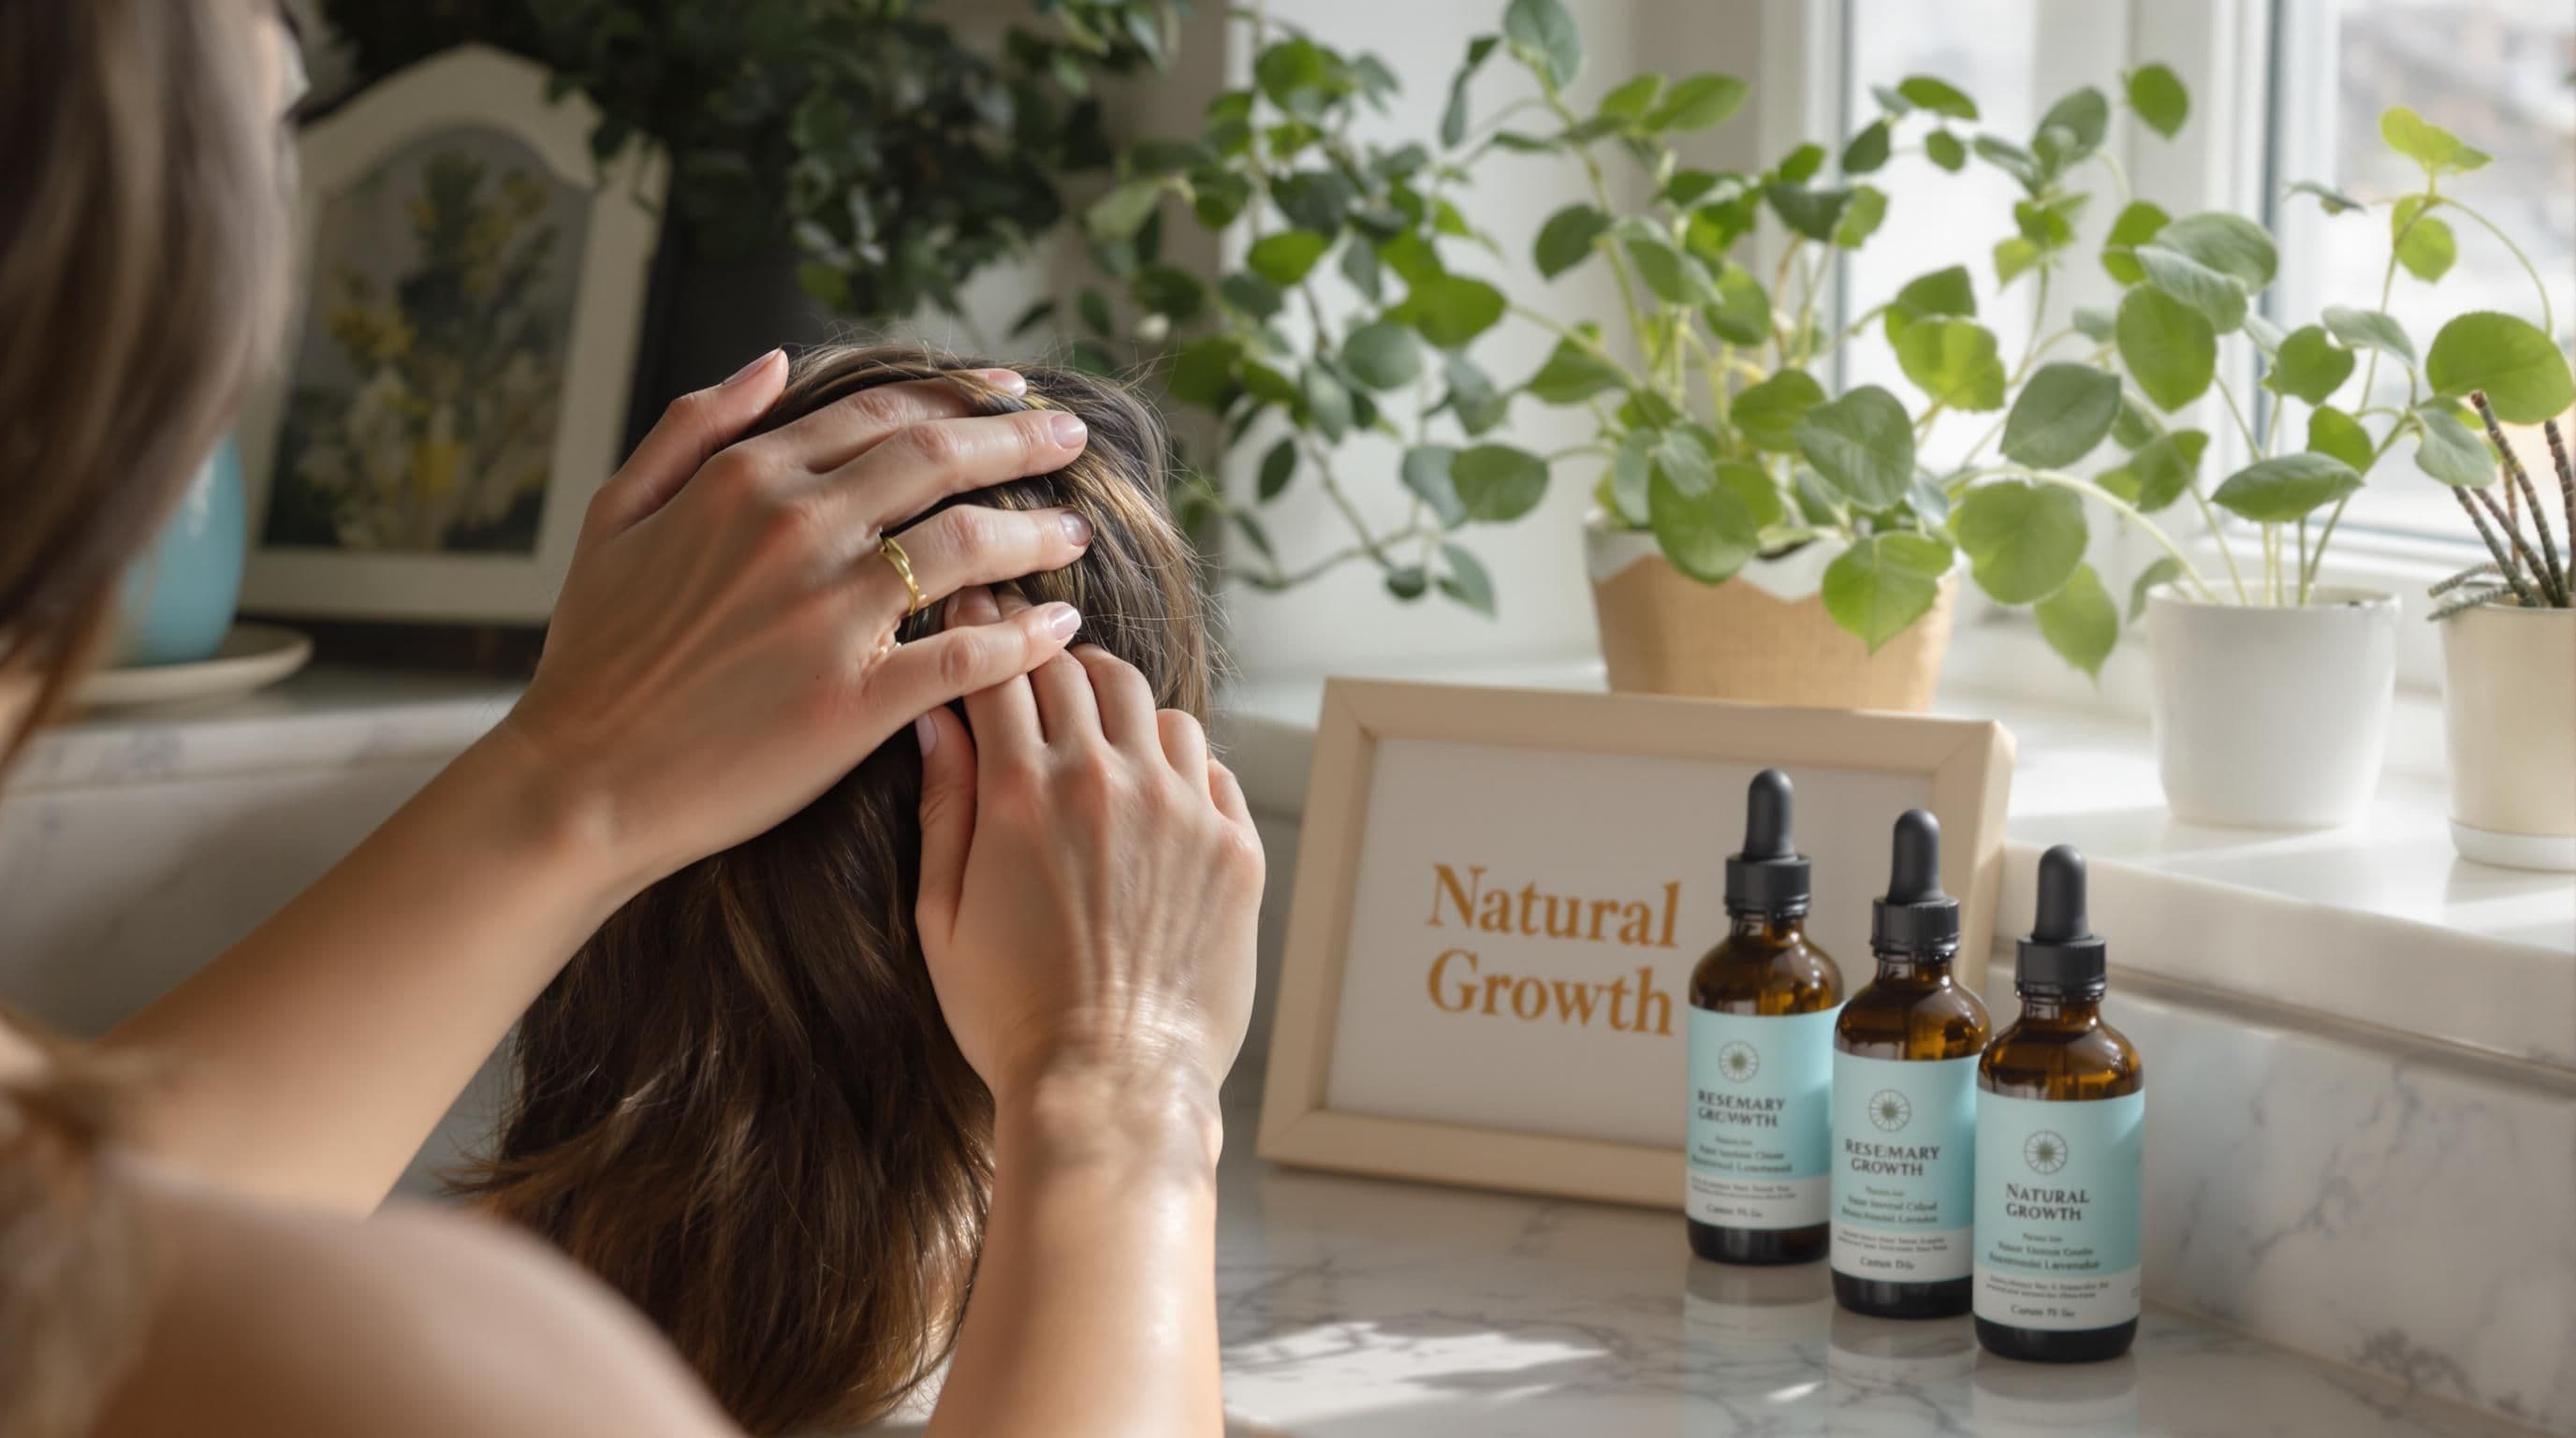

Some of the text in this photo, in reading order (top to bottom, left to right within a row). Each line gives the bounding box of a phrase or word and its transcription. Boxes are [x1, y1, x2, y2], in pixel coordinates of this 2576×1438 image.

[1425, 861, 1683, 948] Natural
[1427, 947, 1674, 1036] Growth
[1851, 1157, 1925, 1177] GROWTH
[2006, 1182, 2091, 1205] NATURAL
[2006, 1202, 2083, 1222] GROWTH
